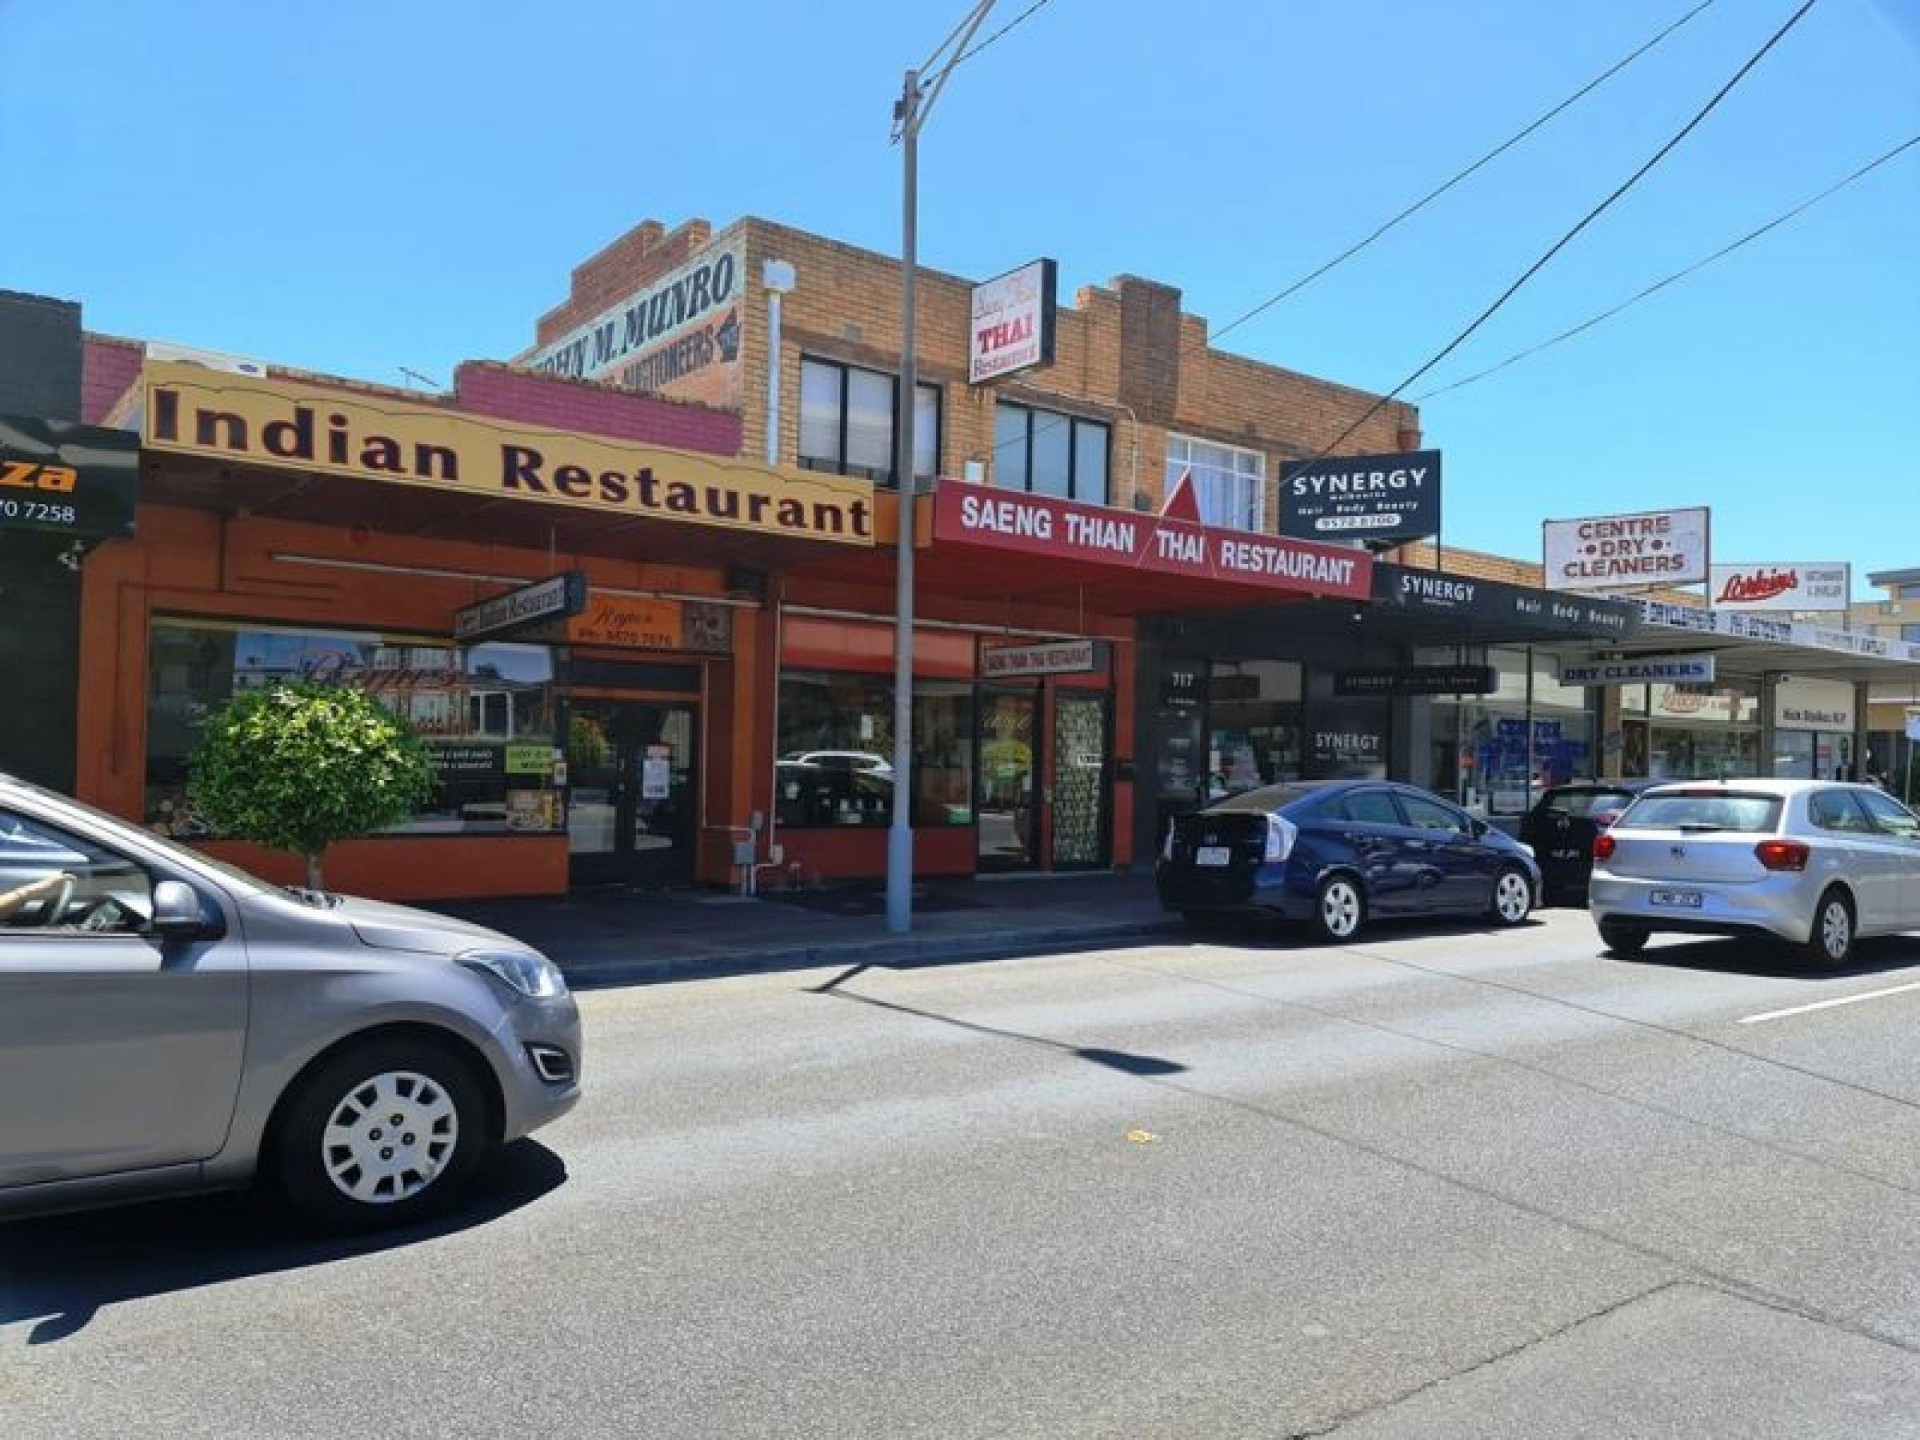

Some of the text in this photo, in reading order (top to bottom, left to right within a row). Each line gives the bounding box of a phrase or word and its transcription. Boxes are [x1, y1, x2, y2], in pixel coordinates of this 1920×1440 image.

[619, 252, 734, 355] MUNRO
[977, 312, 1033, 353] THAI
[152, 387, 871, 538] Indian Restaurant
[1292, 467, 1428, 496] SYNERGY
[23, 502, 76, 523] 7258
[1578, 515, 1671, 541] CENTRE
[961, 495, 1356, 587] SAENG THIAN THAI RESTAURANT
[1599, 537, 1647, 557] DRY
[1563, 553, 1685, 577] CLEANERS
[1401, 575, 1476, 602] SYNERGY
[1551, 601, 1580, 622] Body
[1172, 671, 1194, 687] 717
[1564, 662, 1706, 682] DRY CLEANERS
[1314, 731, 1381, 751] SYNERGY
